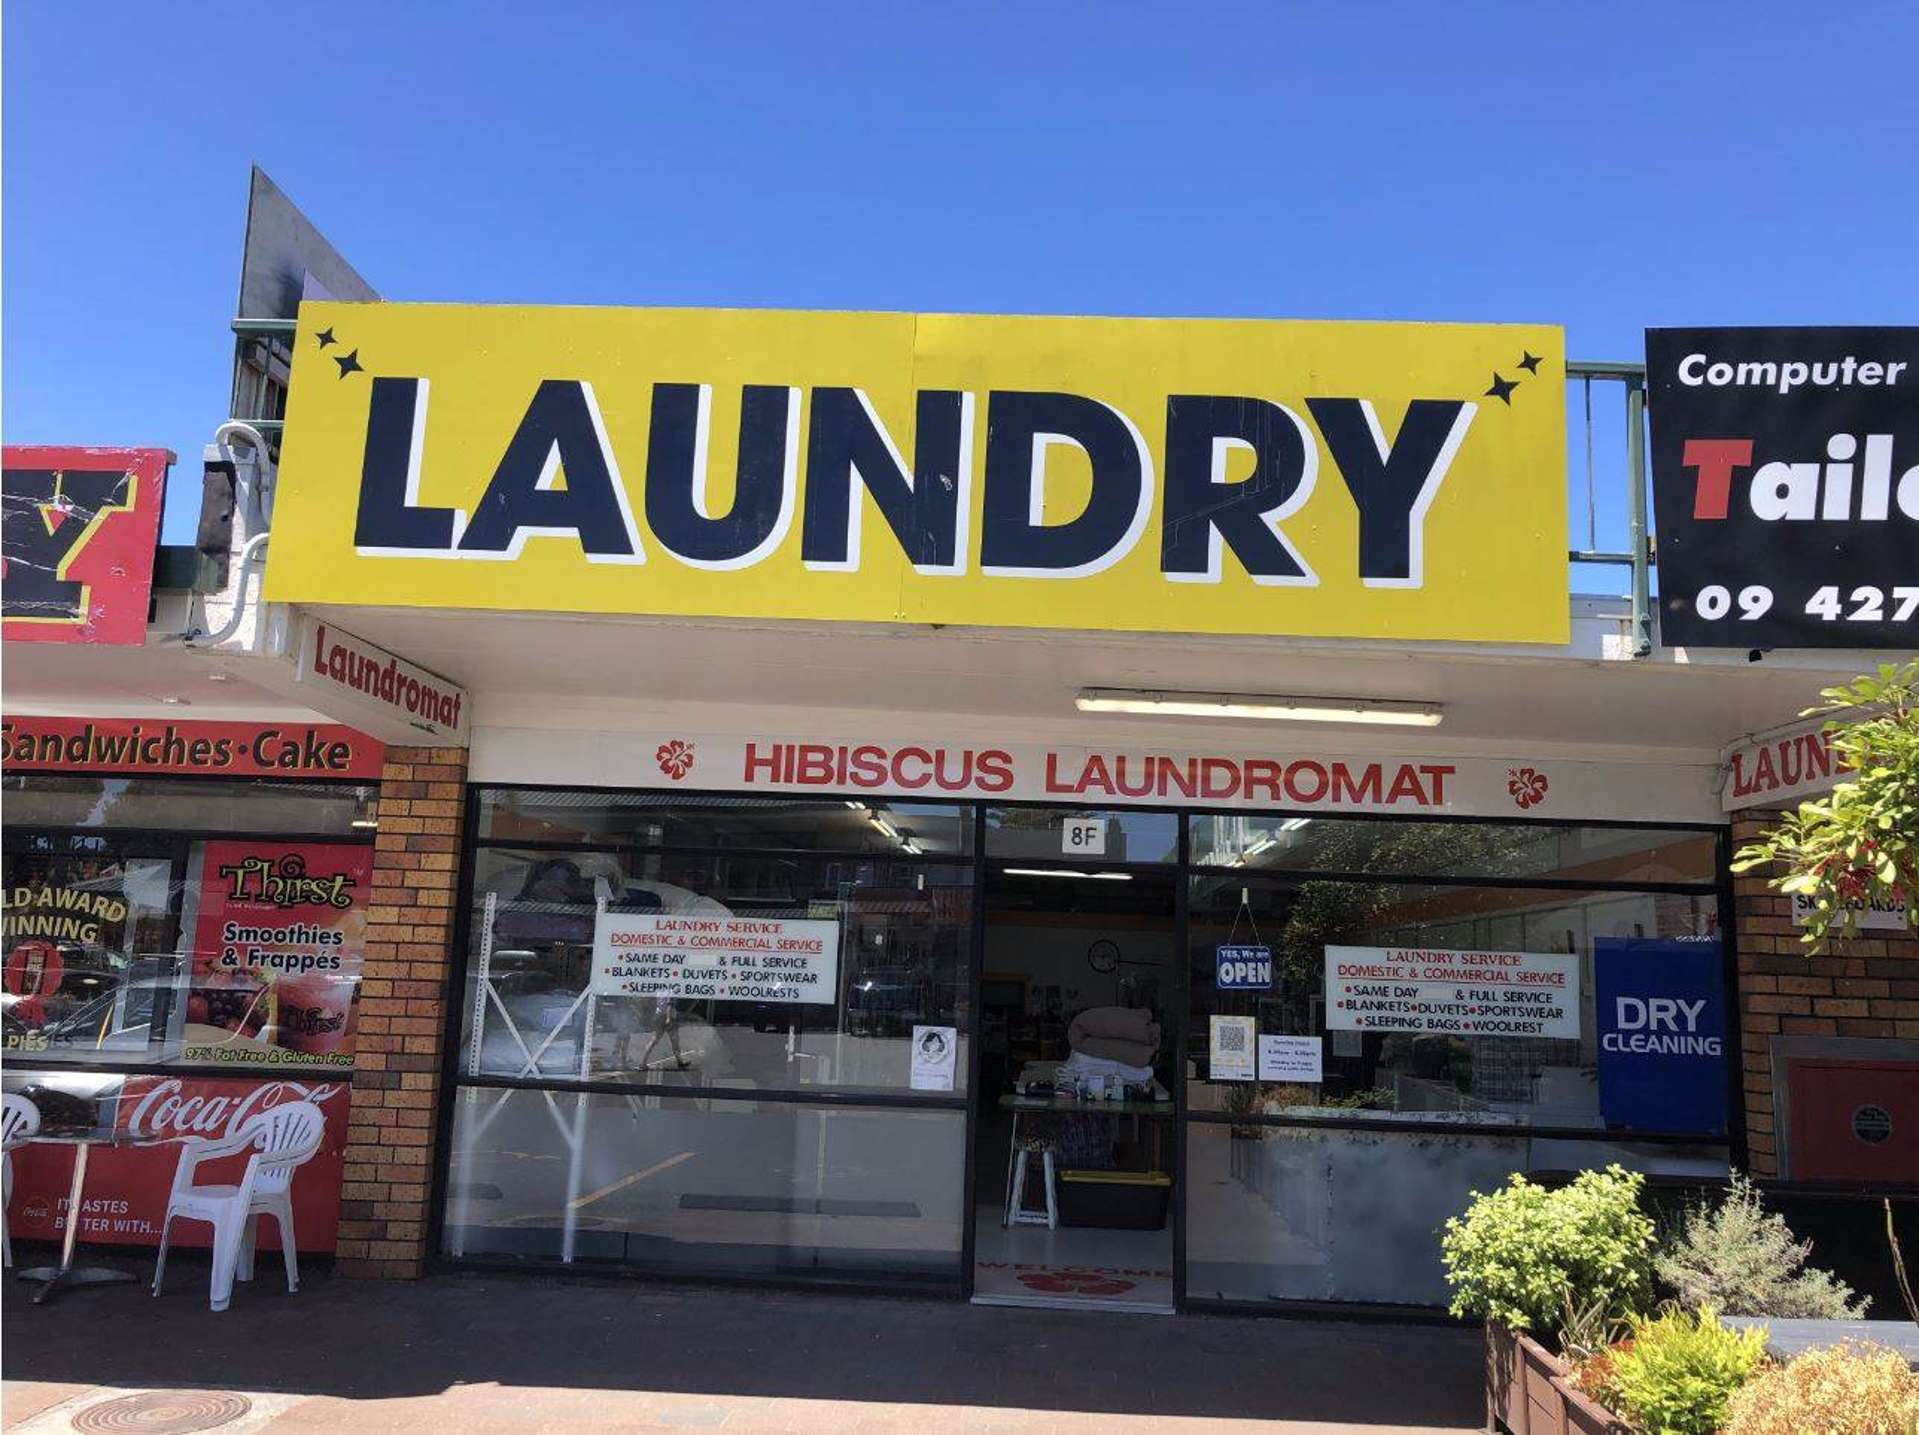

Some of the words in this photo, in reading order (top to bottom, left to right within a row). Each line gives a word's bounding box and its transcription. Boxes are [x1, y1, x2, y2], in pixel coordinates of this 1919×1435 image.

[1678, 354, 1907, 394] Computer
[354, 377, 1478, 590] LAUNDRY
[1695, 585, 1774, 621] 09
[1805, 585, 1919, 622] 427
[314, 625, 461, 729] Laundromat
[2, 723, 232, 768] Sandwiches
[253, 724, 351, 770] Cake
[744, 743, 1014, 792] HIBISCUS
[1045, 753, 1456, 806] LAUNDROMAT
[1070, 827, 1097, 846] 8F
[220, 853, 357, 909] Thirst
[37, 887, 127, 922] AWARD
[224, 921, 344, 945] Smoothies
[656, 920, 720, 934] LAUNDRY
[726, 921, 783, 934] SERVICE
[611, 933, 673, 945] DOMESTIC
[677, 936, 686, 945] &
[690, 936, 772, 949] COMMERCIAL
[777, 939, 823, 950] SERVICE
[221, 948, 239, 967] &
[247, 949, 342, 974] Frappés
[626, 953, 658, 963] SAME
[662, 954, 686, 965] DAY
[719, 956, 727, 965] &
[732, 957, 757, 967] FULL
[762, 958, 808, 969] SERVICE
[1387, 950, 1455, 964] LAUNDRY
[1461, 953, 1522, 966] SERVICE
[612, 967, 671, 978] BLANKETS
[683, 969, 728, 980] DUVETS
[740, 971, 818, 984] SPORTSWEAR
[1220, 962, 1271, 984] OPEN
[1338, 965, 1404, 977] DOMESTIC
[1409, 968, 1418, 978] &
[1424, 968, 1510, 982] COMMERCIAL
[1516, 972, 1565, 984] SERVICE
[629, 982, 682, 994] SLEEPING
[685, 984, 715, 995] BAGS
[729, 987, 800, 999] WOOLRESTS
[1353, 986, 1390, 997] SAME
[1394, 986, 1420, 998] DAY
[1455, 989, 1464, 1000] &
[1470, 990, 1498, 1001] FULL
[1503, 991, 1553, 1004] SERVICE
[1346, 1000, 1410, 1013] BLANKETS
[1418, 1003, 1468, 1015] DUVETS
[1477, 1005, 1563, 1019] SPORTSWEAR
[1616, 996, 1707, 1032] DRY
[1365, 1016, 1422, 1028] SLEEPING
[1427, 1018, 1460, 1030] BAGS
[1473, 1021, 1544, 1033] WOOLREST
[7, 1035, 49, 1051] PIES
[1602, 1033, 1722, 1056] CLEANING
[215, 1049, 236, 1061] Fat
[238, 1049, 266, 1062] Free
[280, 1050, 325, 1064] Gluten
[326, 1051, 354, 1065] Free
[80, 1199, 129, 1214] ASTES
[55, 1216, 110, 1231] BTER
[114, 1218, 162, 1233] WITH...
